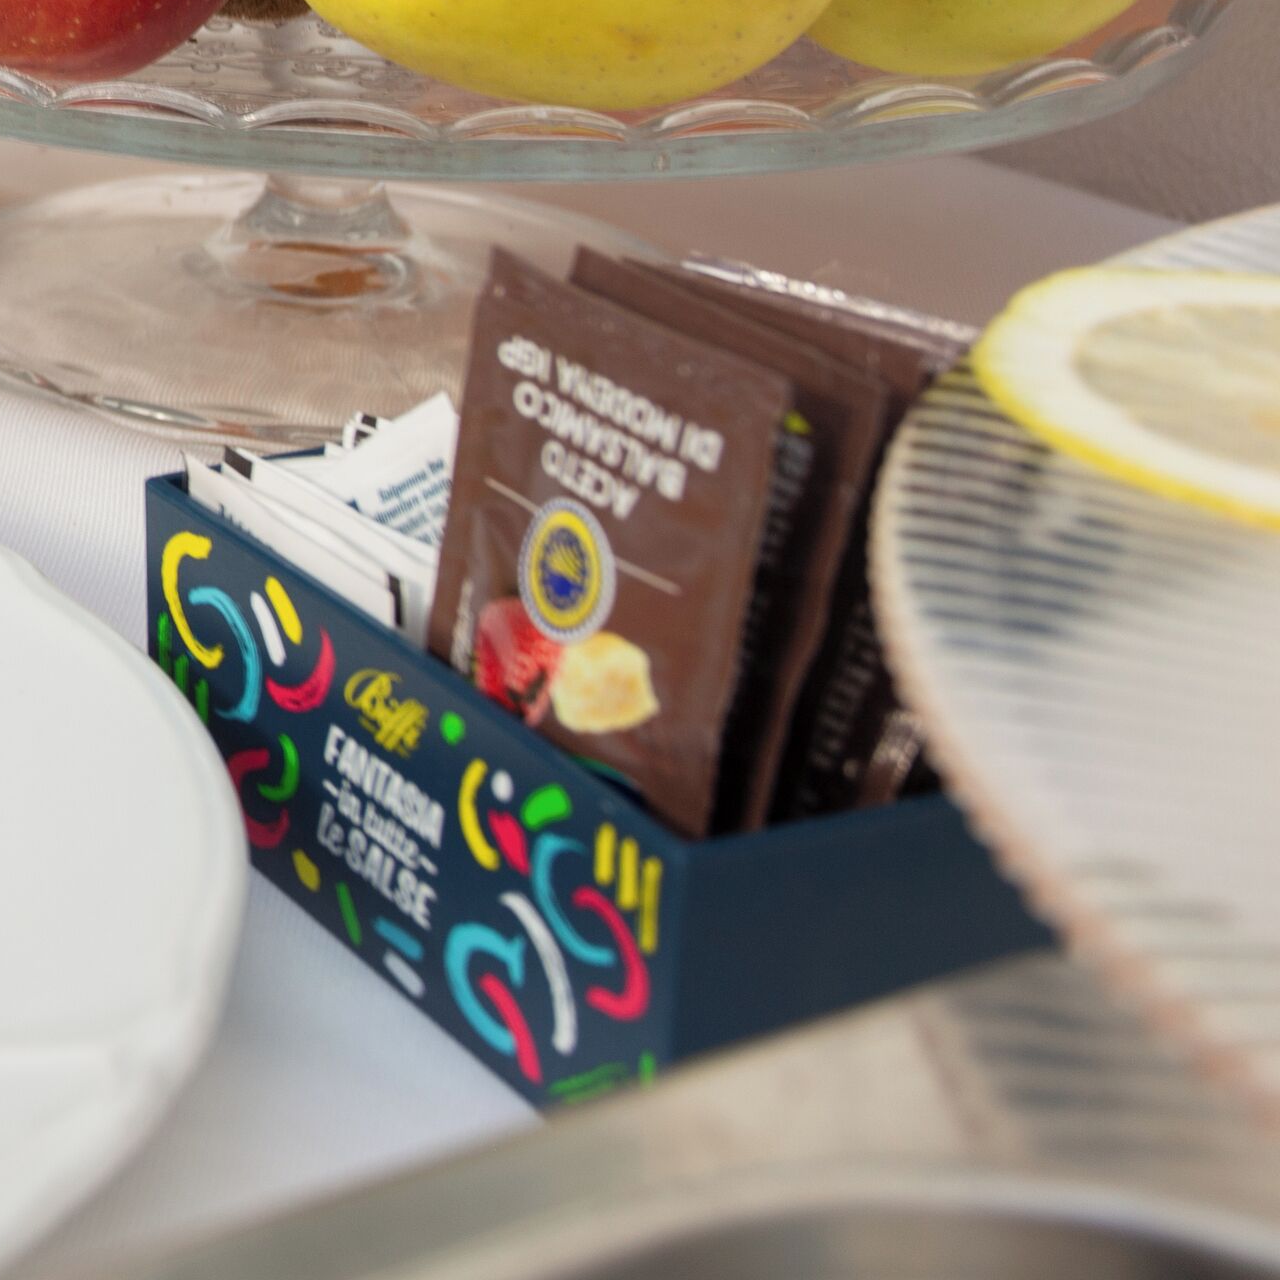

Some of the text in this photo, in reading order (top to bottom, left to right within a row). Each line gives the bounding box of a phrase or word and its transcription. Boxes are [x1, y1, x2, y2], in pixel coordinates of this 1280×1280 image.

[512, 380, 688, 503] BALSAMICO
[555, 353, 684, 454] MODENA
[541, 438, 640, 521] ACETO
[323, 723, 445, 850] FANTASIA
[344, 827, 438, 932] SALSE
